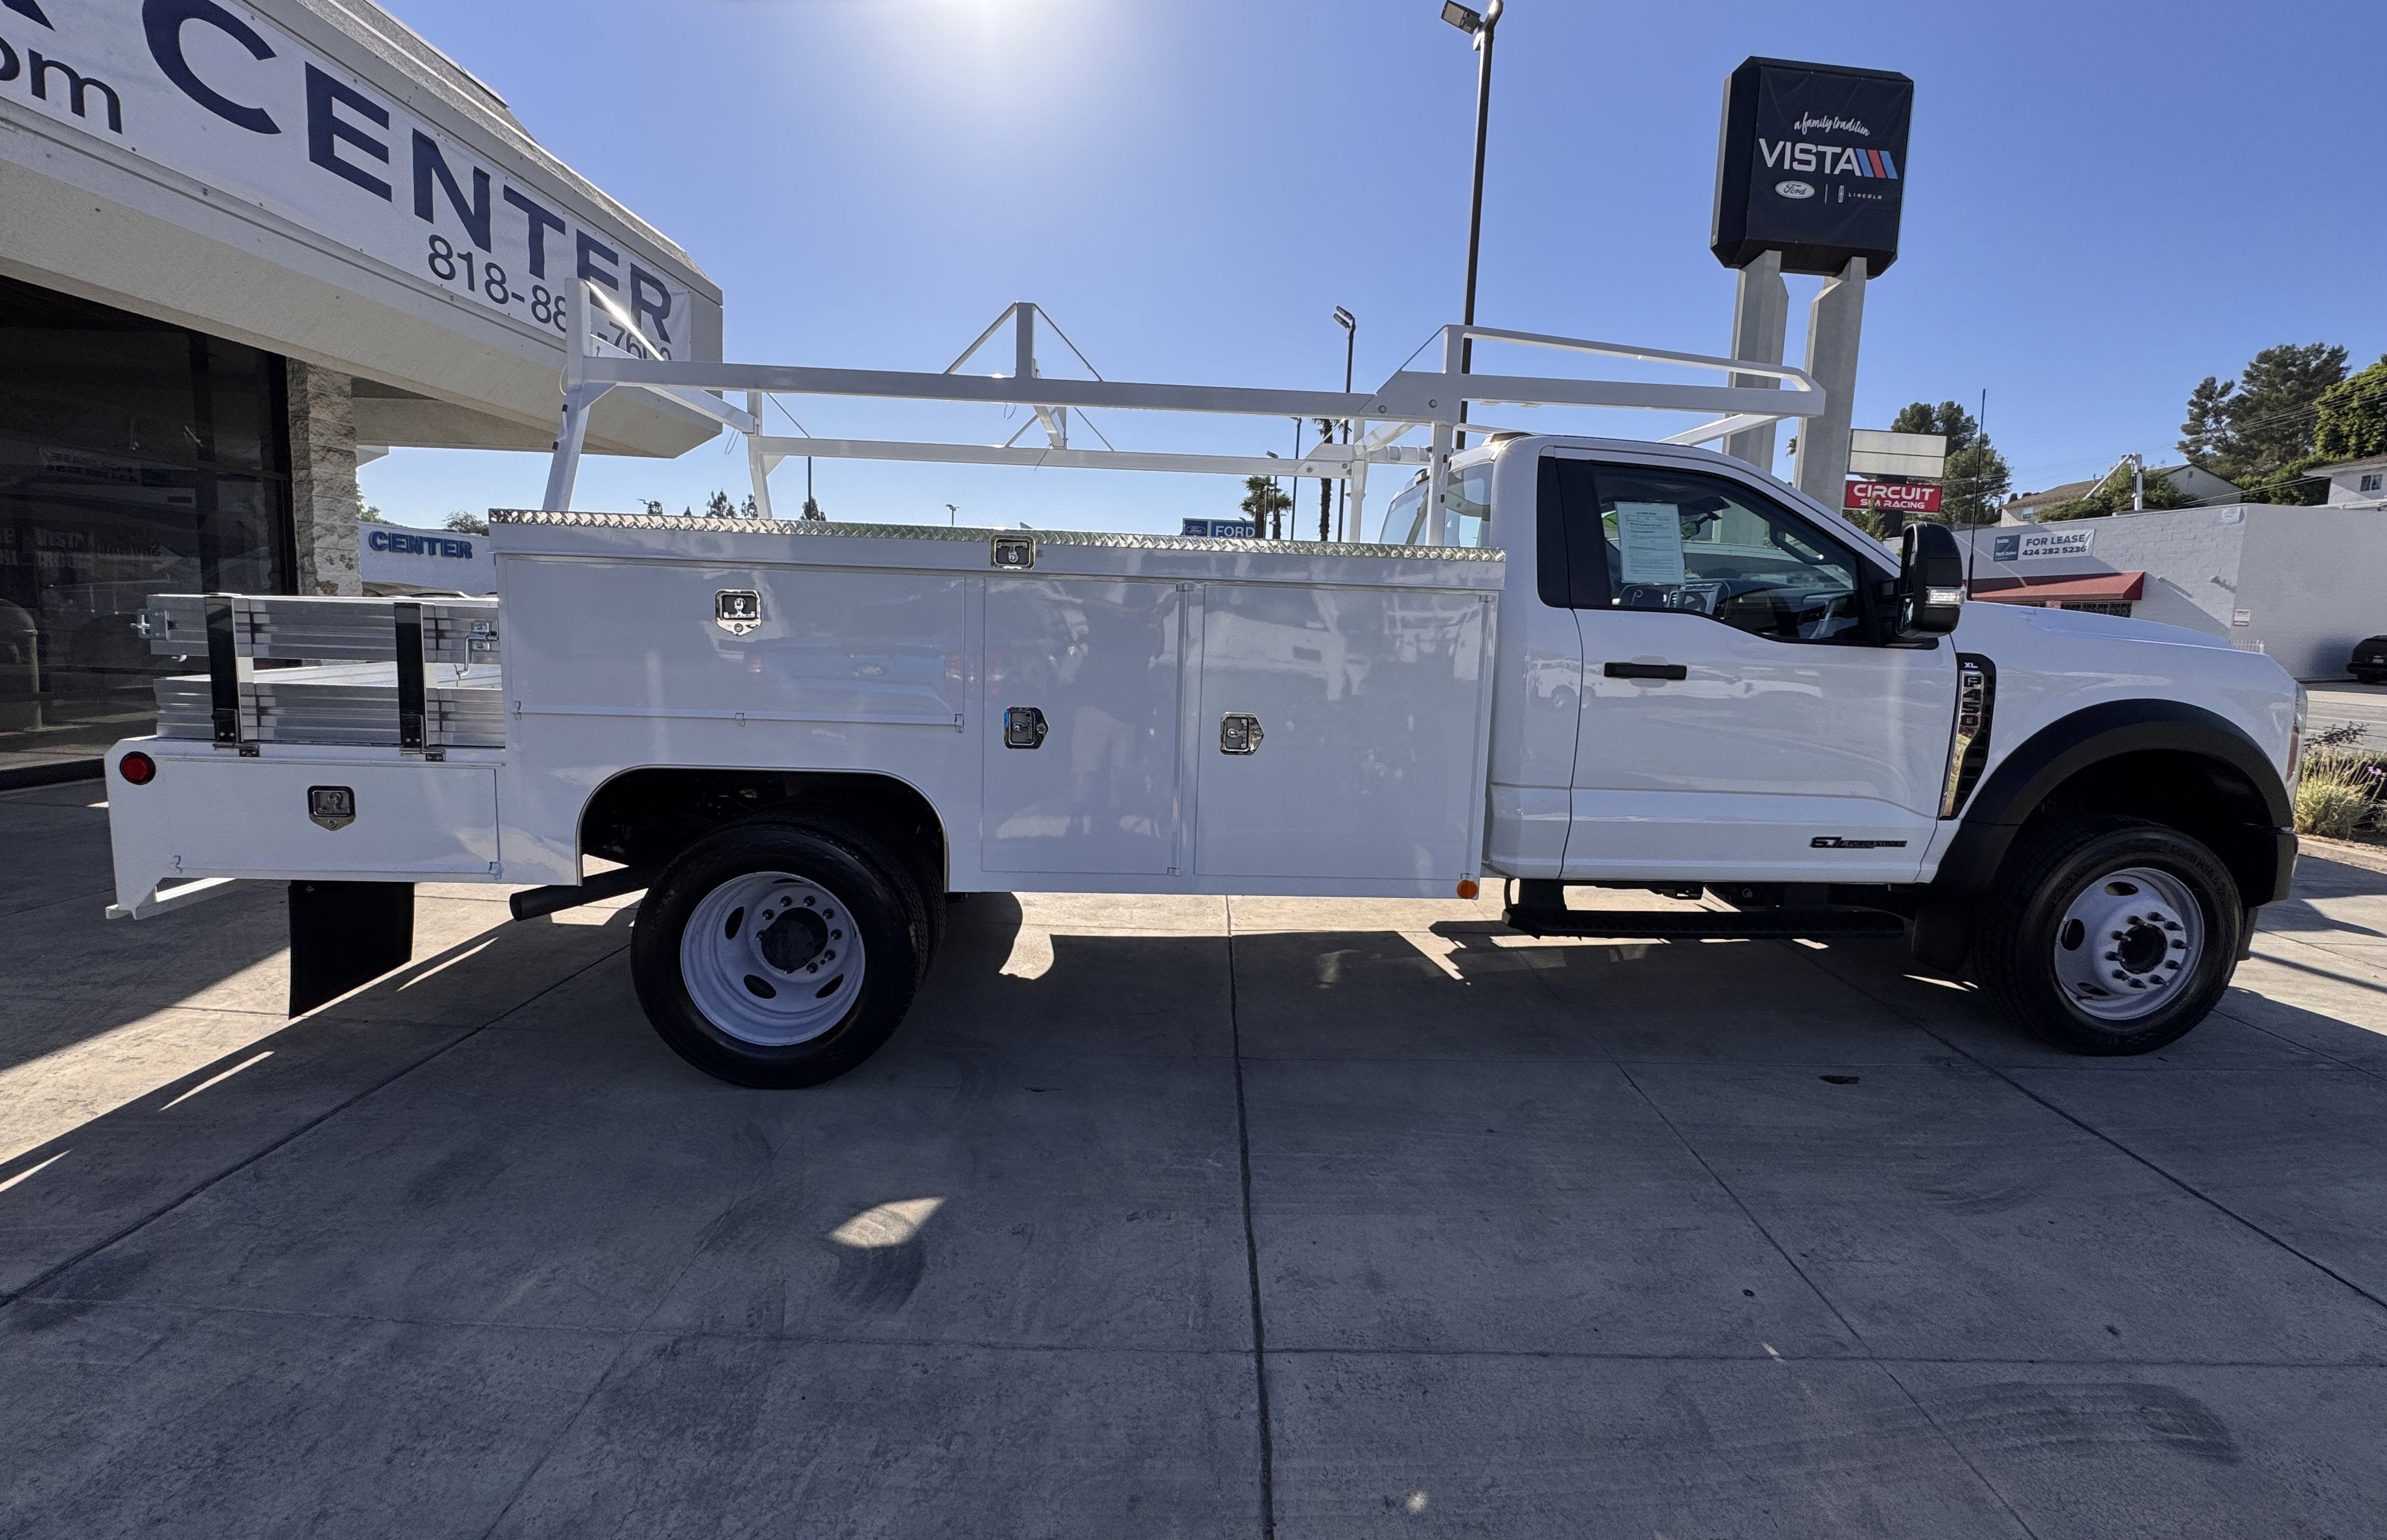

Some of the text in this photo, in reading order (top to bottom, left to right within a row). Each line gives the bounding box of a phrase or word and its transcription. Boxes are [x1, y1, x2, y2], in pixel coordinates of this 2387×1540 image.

[1794, 111, 1871, 136] a family tradition
[1759, 138, 1862, 177] VISTA
[142, 0, 672, 345] CENTER
[1783, 183, 1807, 195] Ford
[1853, 484, 1935, 500] CIRCUIT
[1883, 500, 1925, 509] RACING
[1215, 525, 1256, 538] FORD
[368, 531, 473, 559] CENTER
[2026, 534, 2086, 546] FOR LEASE
[2062, 546, 2087, 554] 5236
